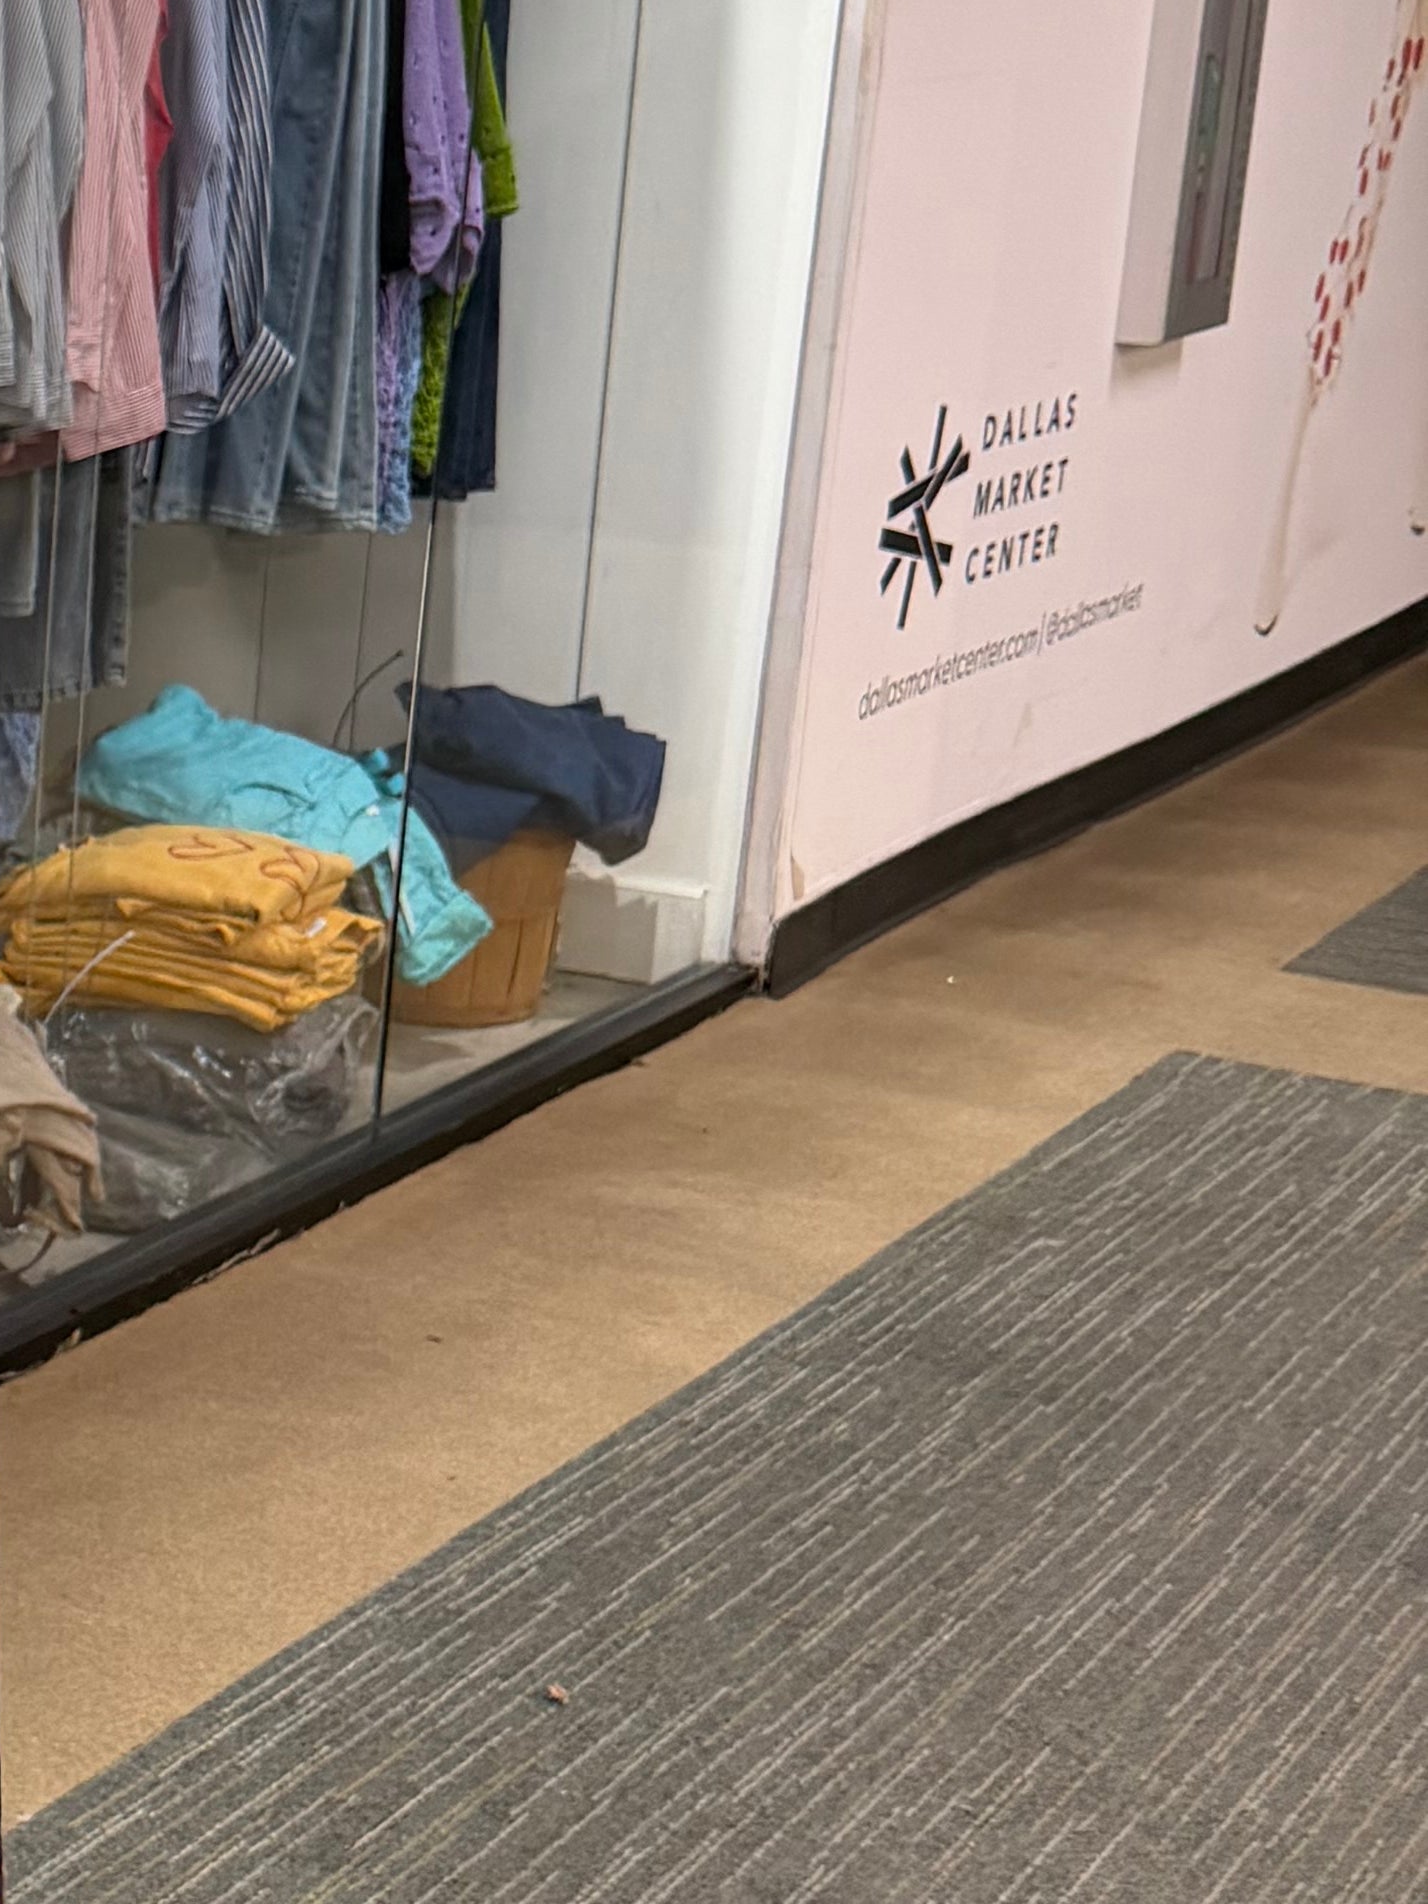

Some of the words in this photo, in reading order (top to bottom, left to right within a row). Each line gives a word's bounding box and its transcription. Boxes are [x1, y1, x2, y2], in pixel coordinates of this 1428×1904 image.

[982, 393, 1077, 451] DALLAS
[973, 456, 1068, 519] MARKET
[965, 521, 1059, 585] CENTER
